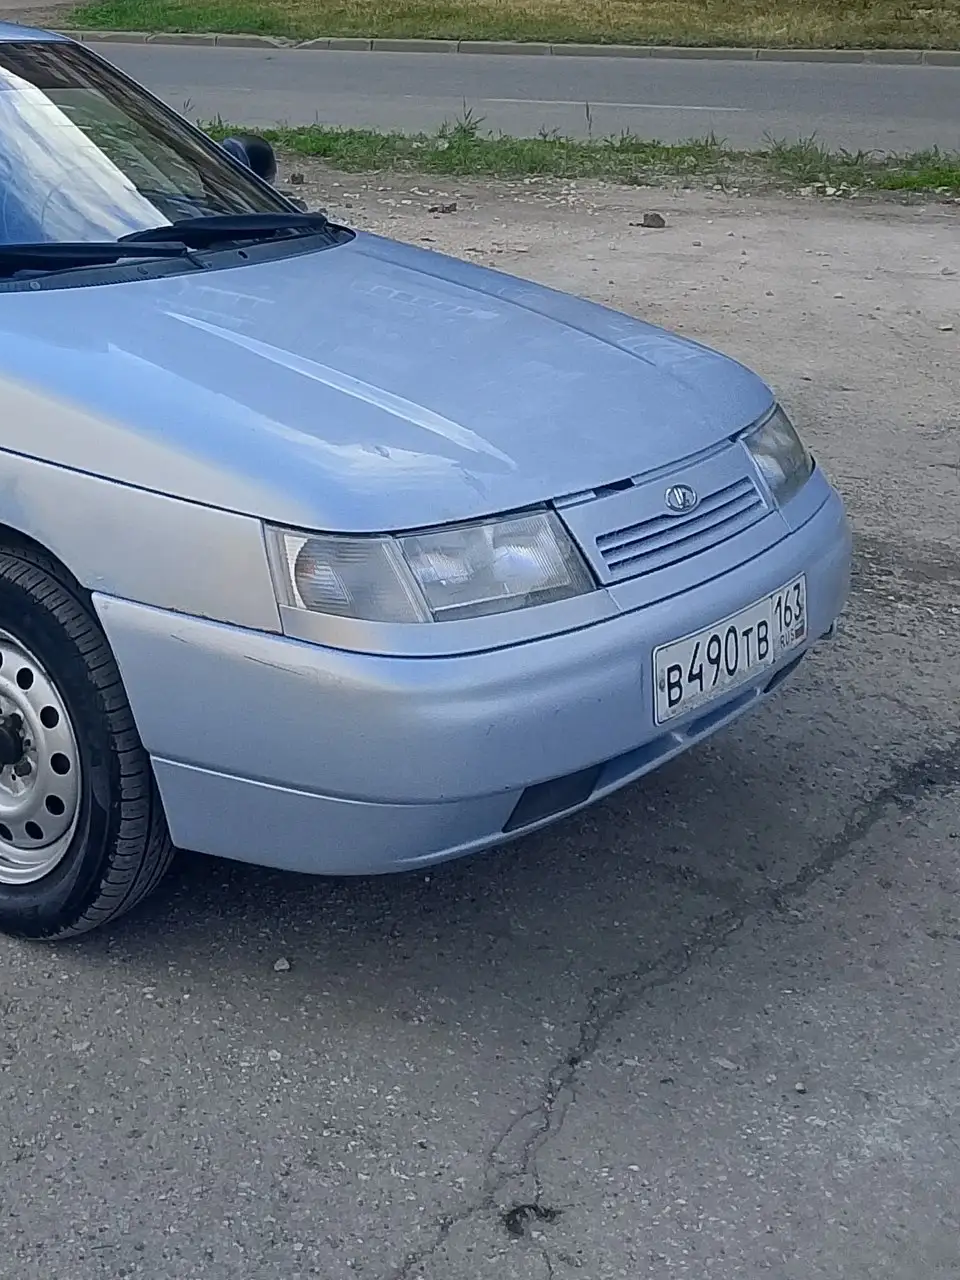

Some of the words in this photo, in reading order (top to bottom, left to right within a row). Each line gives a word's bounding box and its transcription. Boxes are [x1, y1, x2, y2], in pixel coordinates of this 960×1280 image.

[666, 620, 769, 708] В490ТВ
[774, 582, 804, 632] 163
[780, 629, 795, 648] RUS
